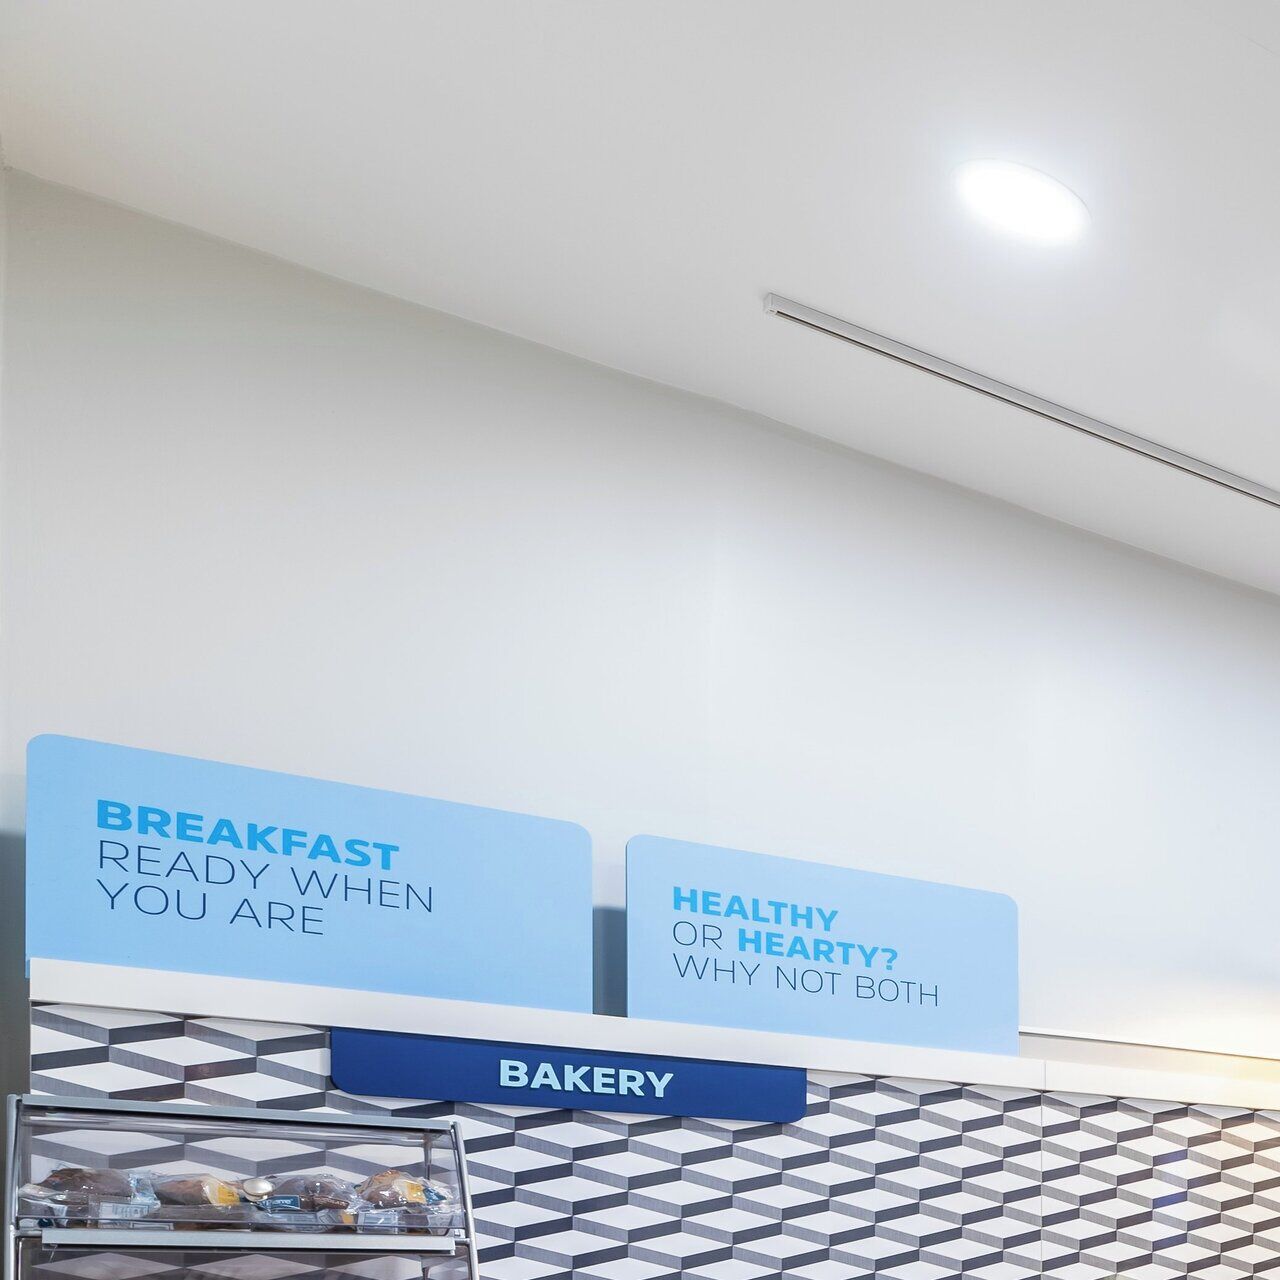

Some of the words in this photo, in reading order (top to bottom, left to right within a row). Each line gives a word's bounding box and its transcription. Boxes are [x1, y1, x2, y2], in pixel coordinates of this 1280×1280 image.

[97, 799, 400, 870] BREAKFAST
[99, 840, 270, 890] READY
[290, 866, 432, 913] WHEN
[96, 878, 207, 920] YOU
[229, 897, 324, 936] ARE
[673, 886, 839, 932] HEALTHY
[673, 920, 722, 950] OR
[738, 928, 898, 971] HEARTY?
[673, 952, 761, 986] WHY
[776, 965, 842, 996] NOT
[856, 975, 939, 1007] BOTH
[500, 1059, 674, 1098] BAKERY
